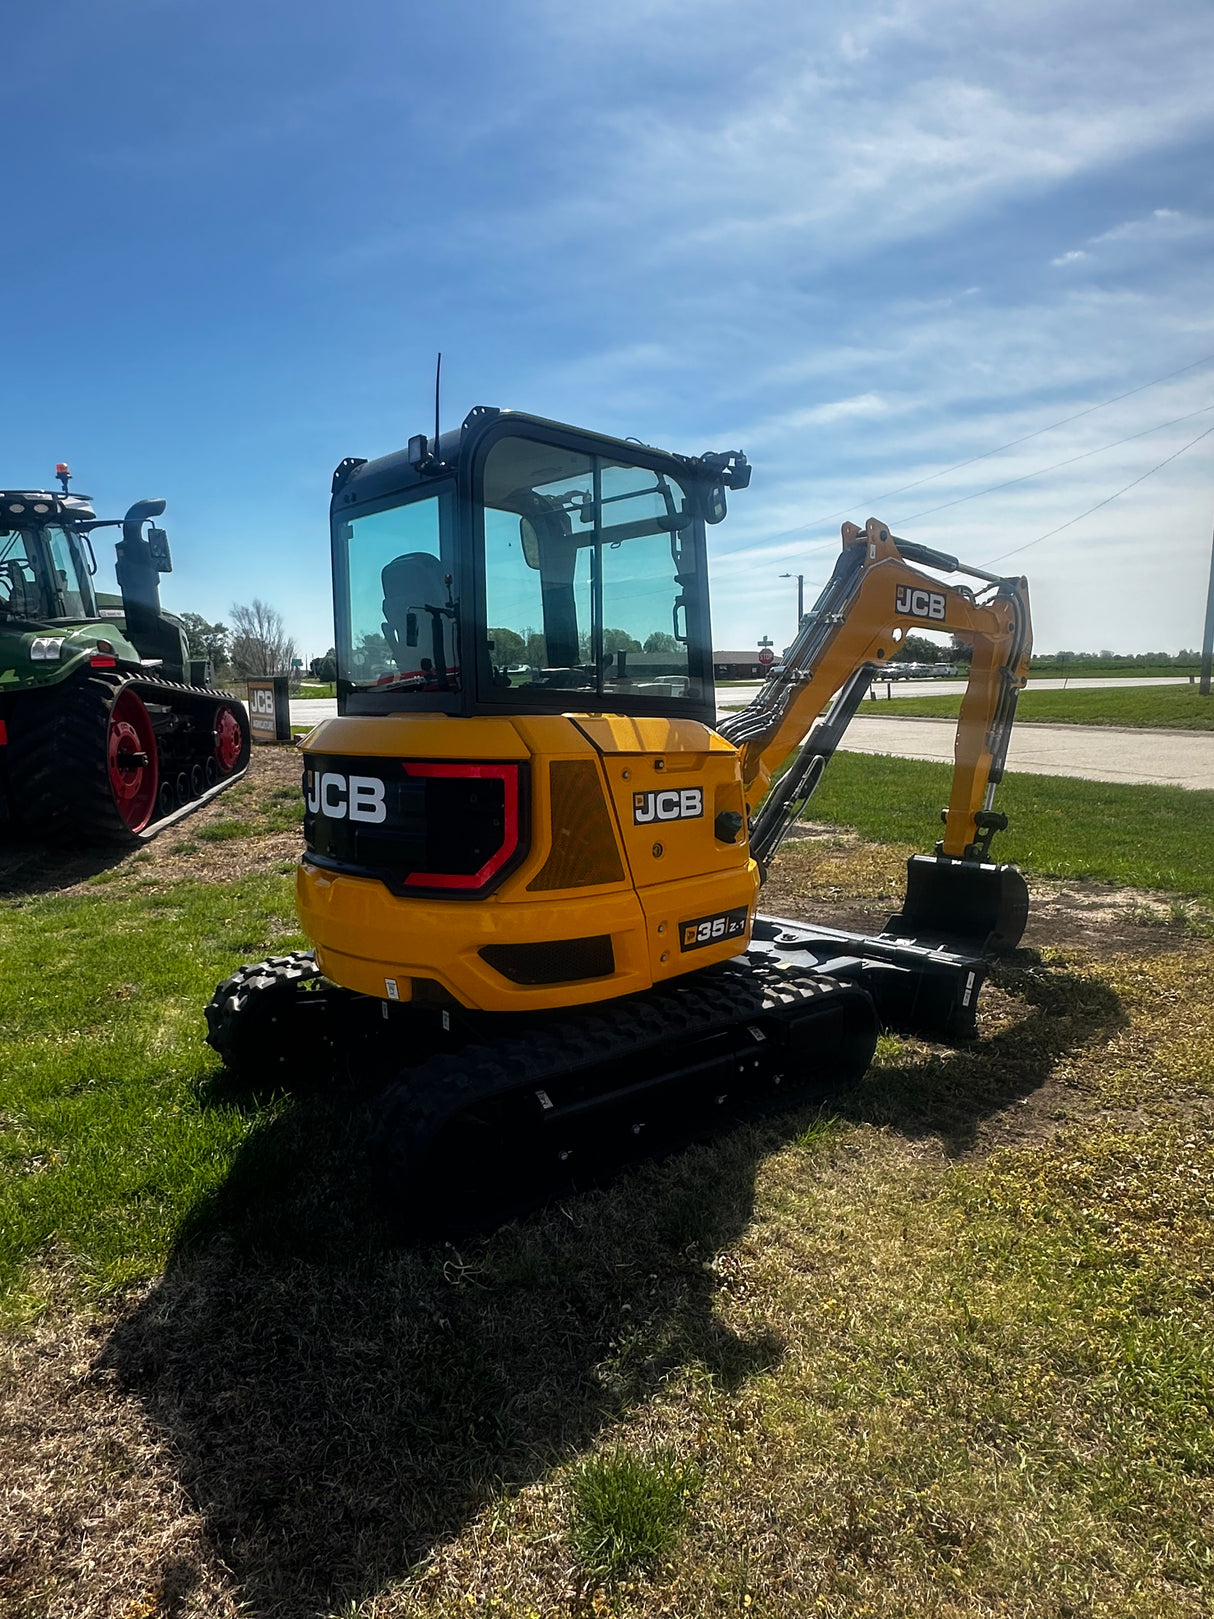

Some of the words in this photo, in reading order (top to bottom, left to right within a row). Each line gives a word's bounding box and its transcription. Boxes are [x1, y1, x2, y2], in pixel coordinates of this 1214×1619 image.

[896, 588, 946, 619] JCB
[251, 690, 274, 713] JCB
[308, 771, 387, 824] JCB
[635, 789, 702, 822] JCB
